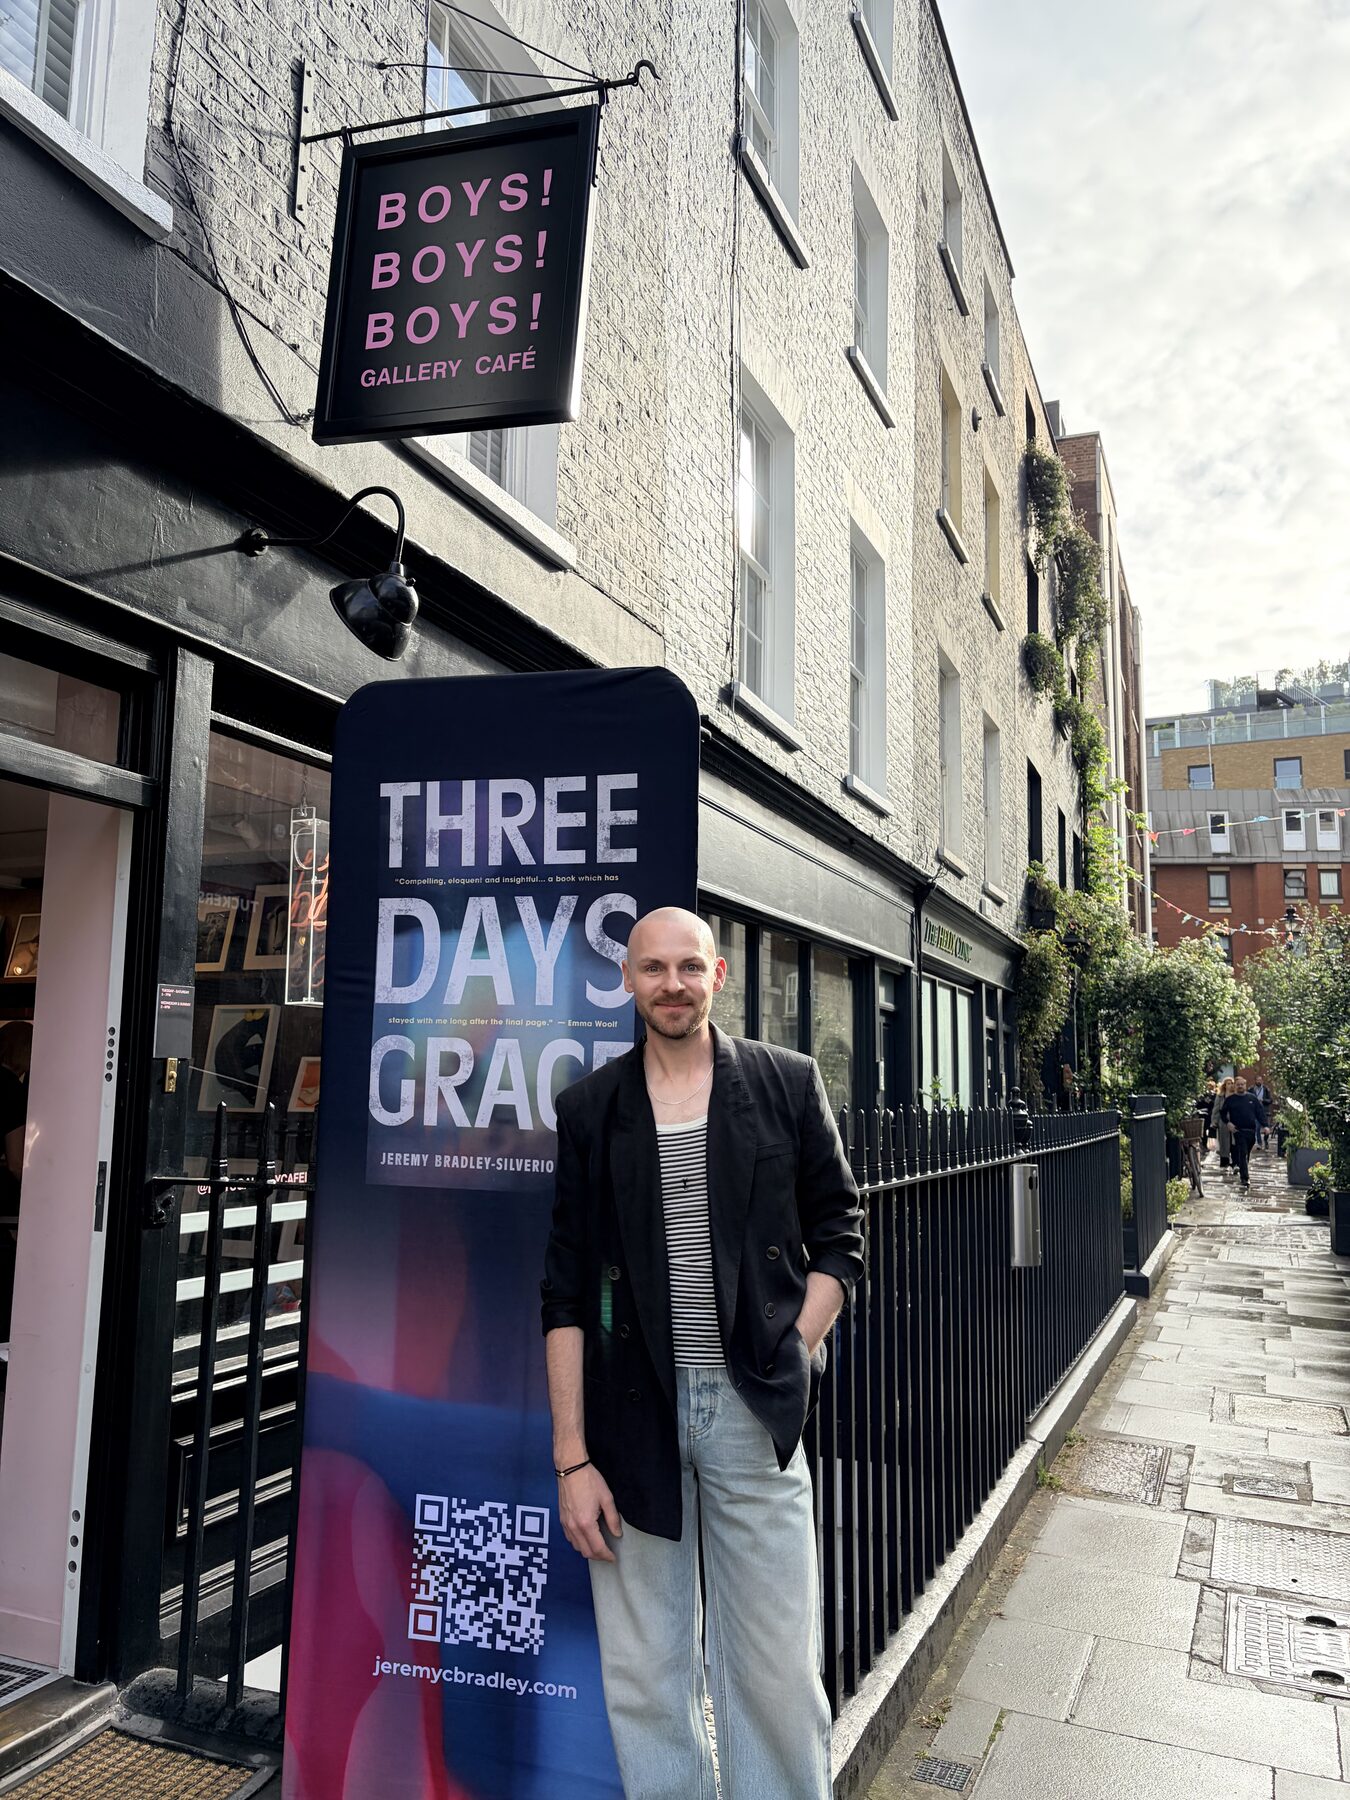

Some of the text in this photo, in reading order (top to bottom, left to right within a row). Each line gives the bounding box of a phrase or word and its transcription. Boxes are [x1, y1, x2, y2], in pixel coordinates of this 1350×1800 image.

[377, 168, 553, 231] BOYS!
[371, 230, 547, 290] BOYS!
[365, 293, 542, 350] BOYS!
[360, 345, 536, 388] GALLERY CAFÉ
[379, 773, 638, 869] THREE
[447, 877, 483, 885] eloquent
[484, 876, 501, 884] and
[502, 875, 546, 885] insightful...
[555, 875, 576, 883] book
[577, 874, 602, 883] which
[604, 874, 619, 882] has
[374, 892, 638, 1009] DAYS
[388, 1017, 415, 1025] stayed
[435, 1017, 448, 1025] me
[449, 1017, 467, 1026] long
[505, 1018, 523, 1026] final
[594, 1020, 618, 1028] Woolf
[368, 1034, 635, 1133] GRAC
[380, 1152, 555, 1174] JEREMY BRADLEY-SILVERIO
[372, 1655, 577, 1700] jeremycbradley.com
